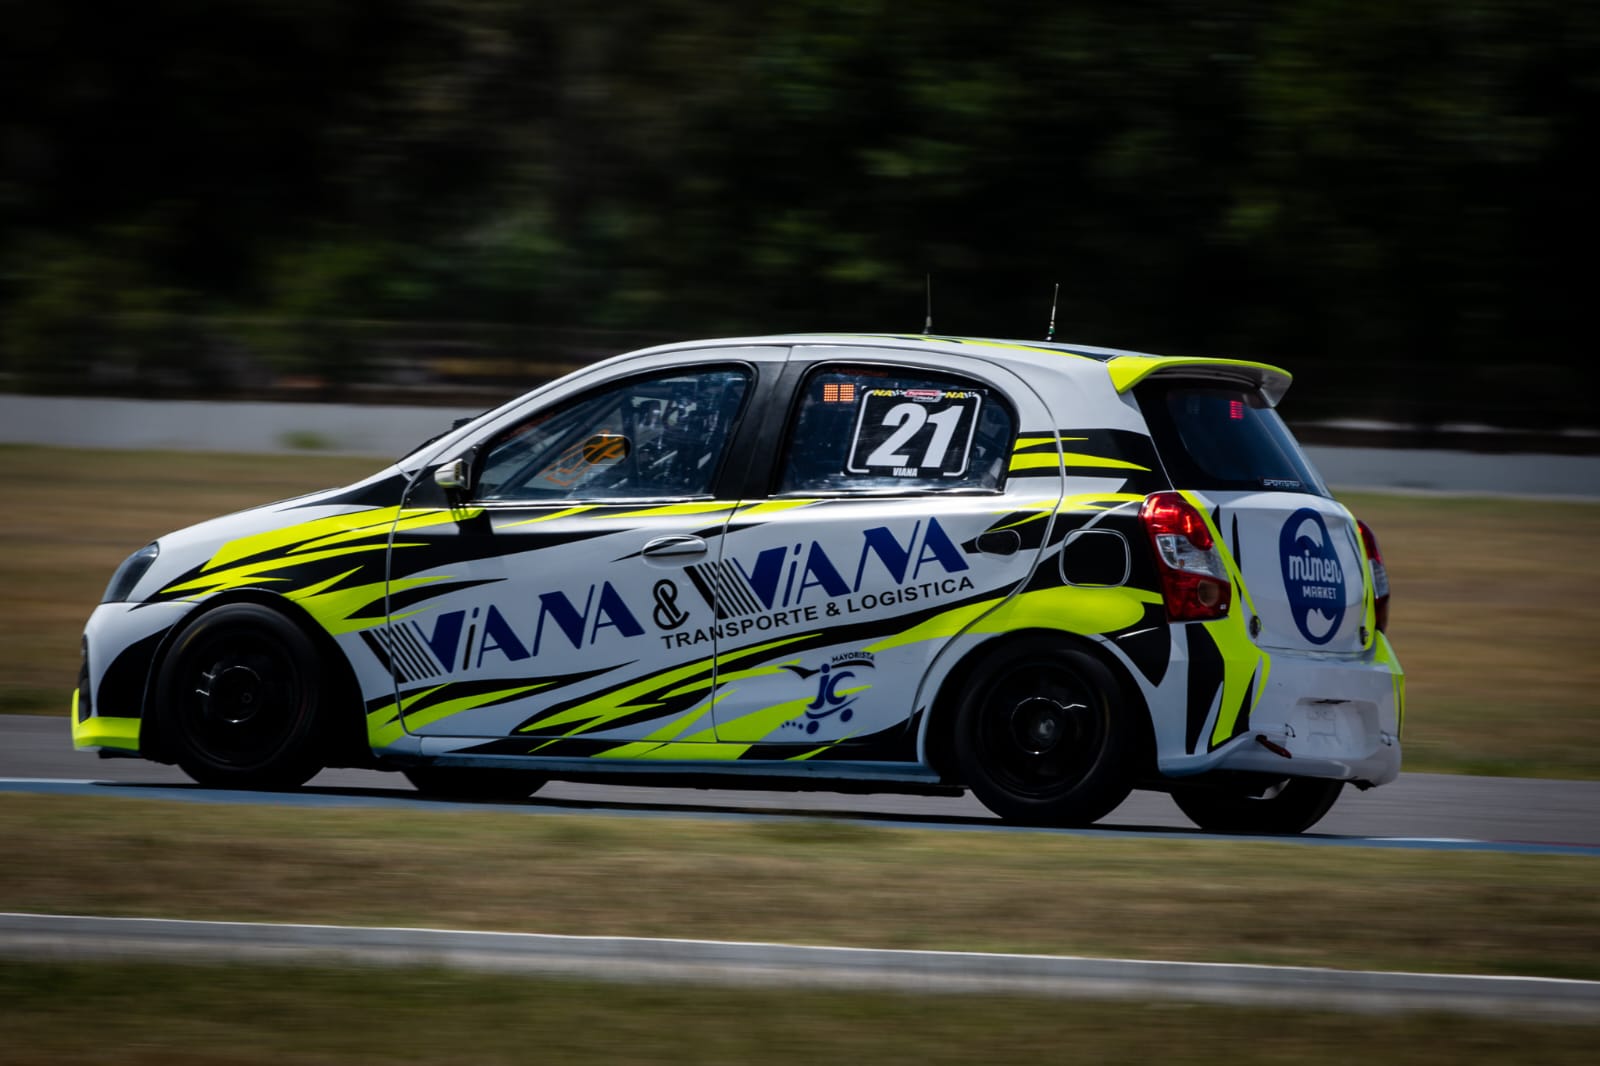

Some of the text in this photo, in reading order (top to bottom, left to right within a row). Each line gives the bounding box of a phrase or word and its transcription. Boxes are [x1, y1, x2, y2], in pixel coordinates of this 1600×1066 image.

[865, 402, 964, 468] 21
[893, 467, 918, 478] VIANA
[1289, 549, 1342, 583] mimen
[1302, 585, 1337, 600] MARKET
[661, 575, 975, 650] TRANSPORTE & LOGISTICA
[831, 651, 874, 662] MAYORISTA
